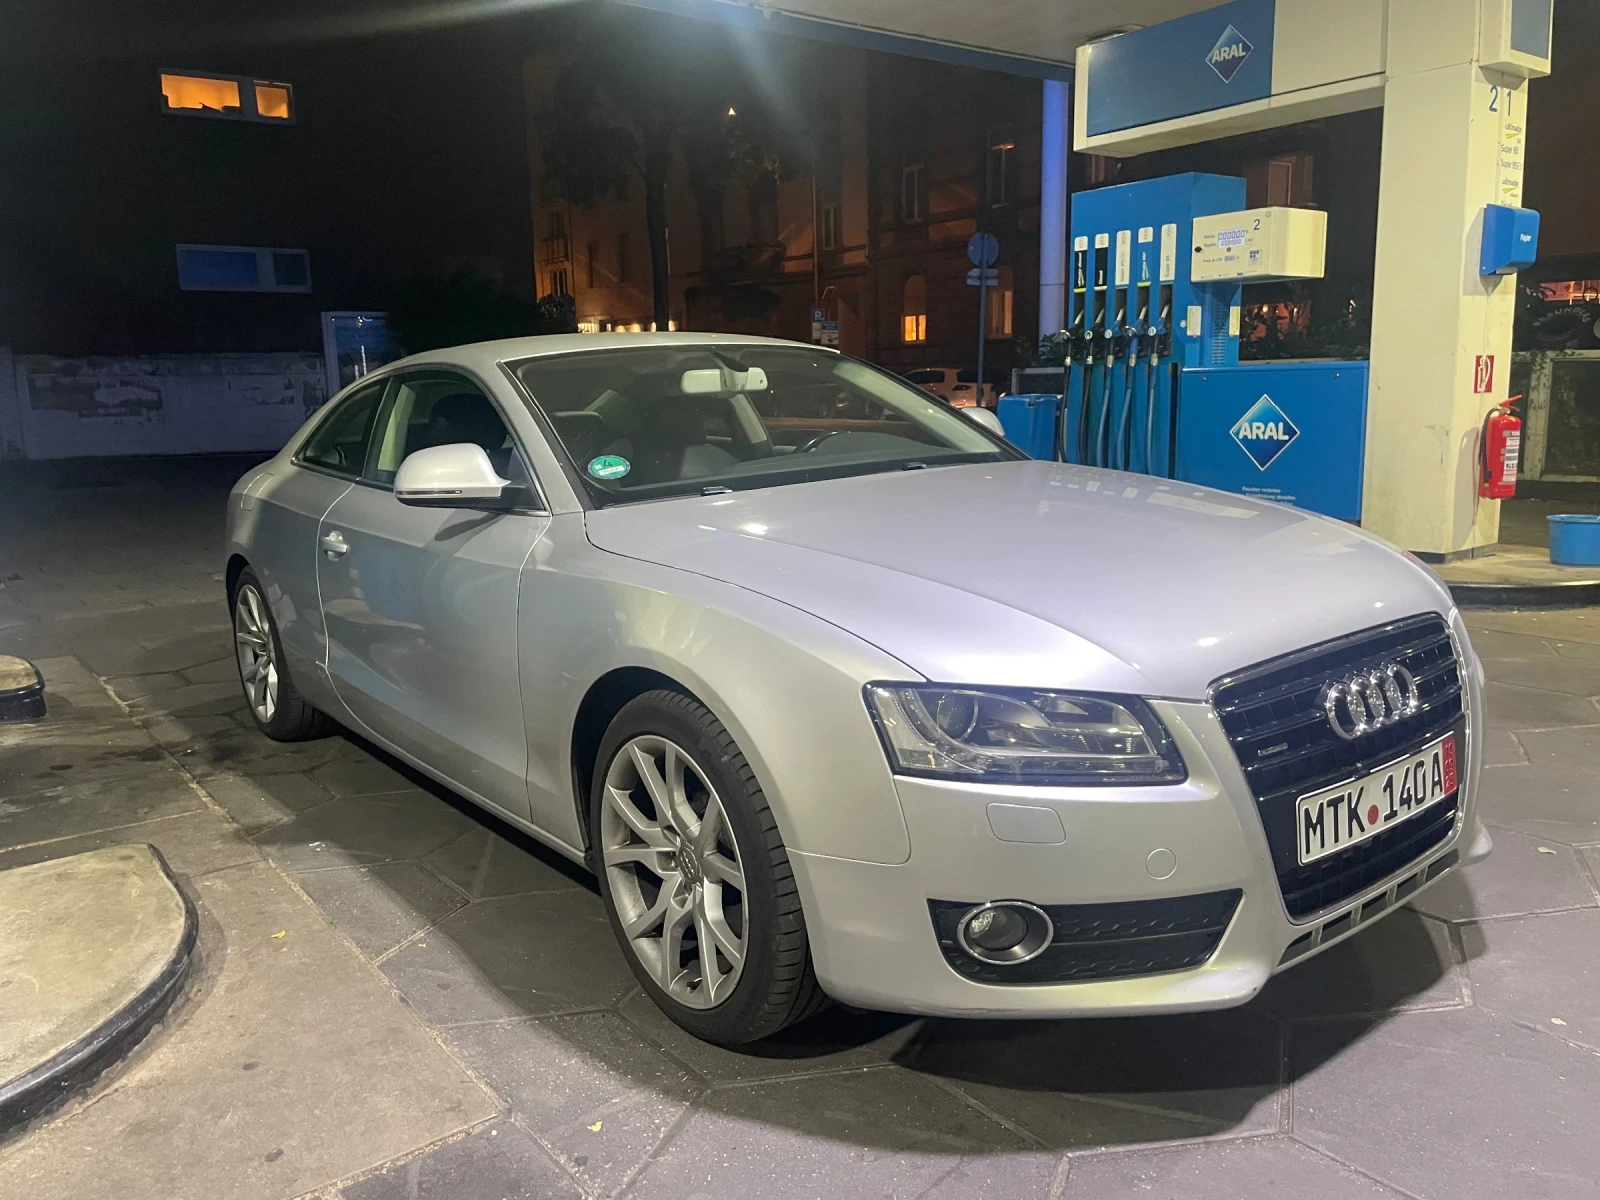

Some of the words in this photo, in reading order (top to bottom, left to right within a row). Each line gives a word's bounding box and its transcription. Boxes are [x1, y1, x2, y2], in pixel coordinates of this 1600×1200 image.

[1211, 42, 1247, 64] ARAL
[1489, 84, 1498, 112] 2
[1506, 89, 1512, 117] 1
[1253, 218, 1261, 231] 2
[814, 310, 822, 321] P
[1239, 422, 1289, 440] ARAL
[604, 459, 612, 467] 4
[1303, 785, 1366, 856] MTK
